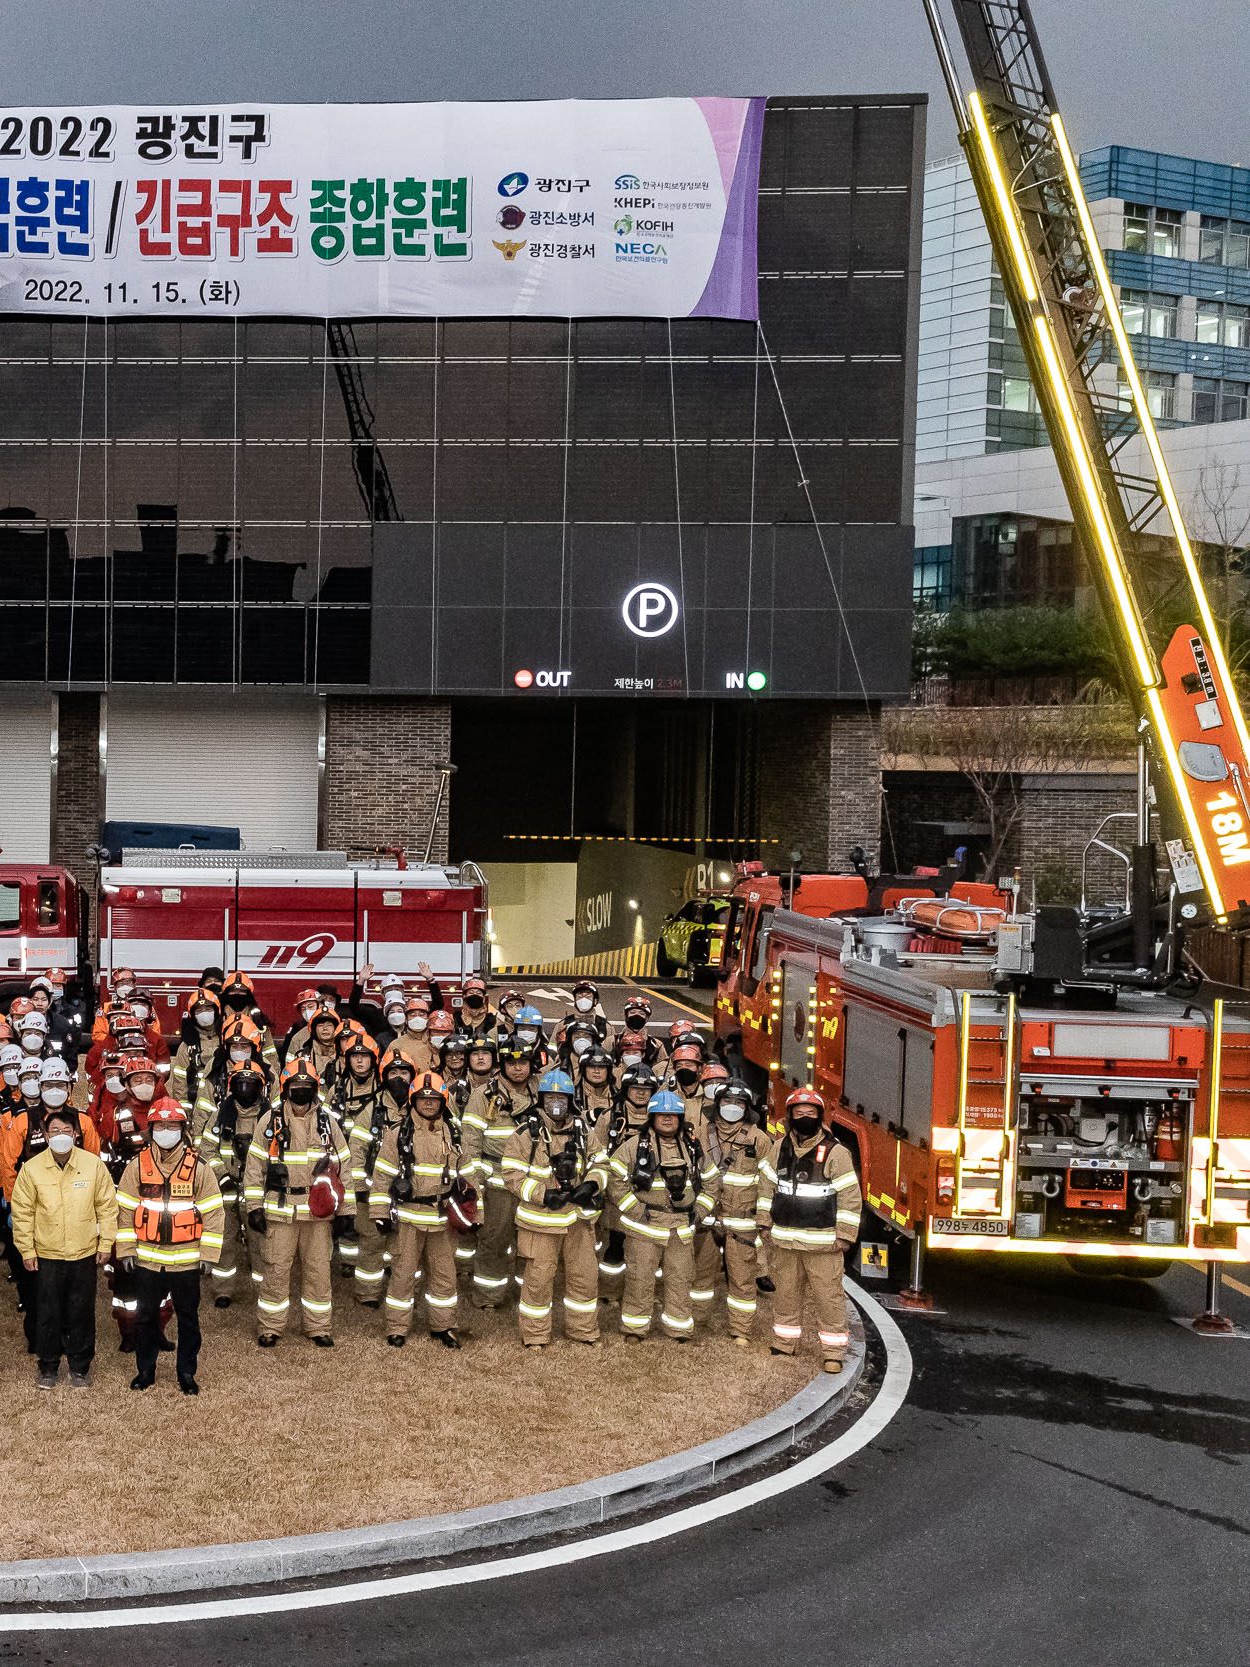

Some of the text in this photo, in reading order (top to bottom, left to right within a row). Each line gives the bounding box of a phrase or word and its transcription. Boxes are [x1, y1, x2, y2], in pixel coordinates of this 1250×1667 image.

[0, 115, 266, 160] 2022 광진구
[535, 178, 591, 193] 광진구
[134, 178, 295, 259] 긴급구조
[310, 176, 468, 260] 종합훈련
[529, 211, 595, 227] 광진소방서
[636, 220, 674, 231] KOFIH
[529, 243, 595, 259] 광진경찰서
[615, 243, 667, 255] NECA
[24, 280, 241, 307] 2022. 11. 15. (화)
[536, 671, 572, 687] OUT
[614, 677, 654, 690] 제한높이
[726, 672, 744, 689] IN
[1206, 791, 1250, 866] 18M
[587, 891, 612, 932] SLOW
[256, 933, 336, 968] 119
[972, 1221, 1004, 1233] 4850
